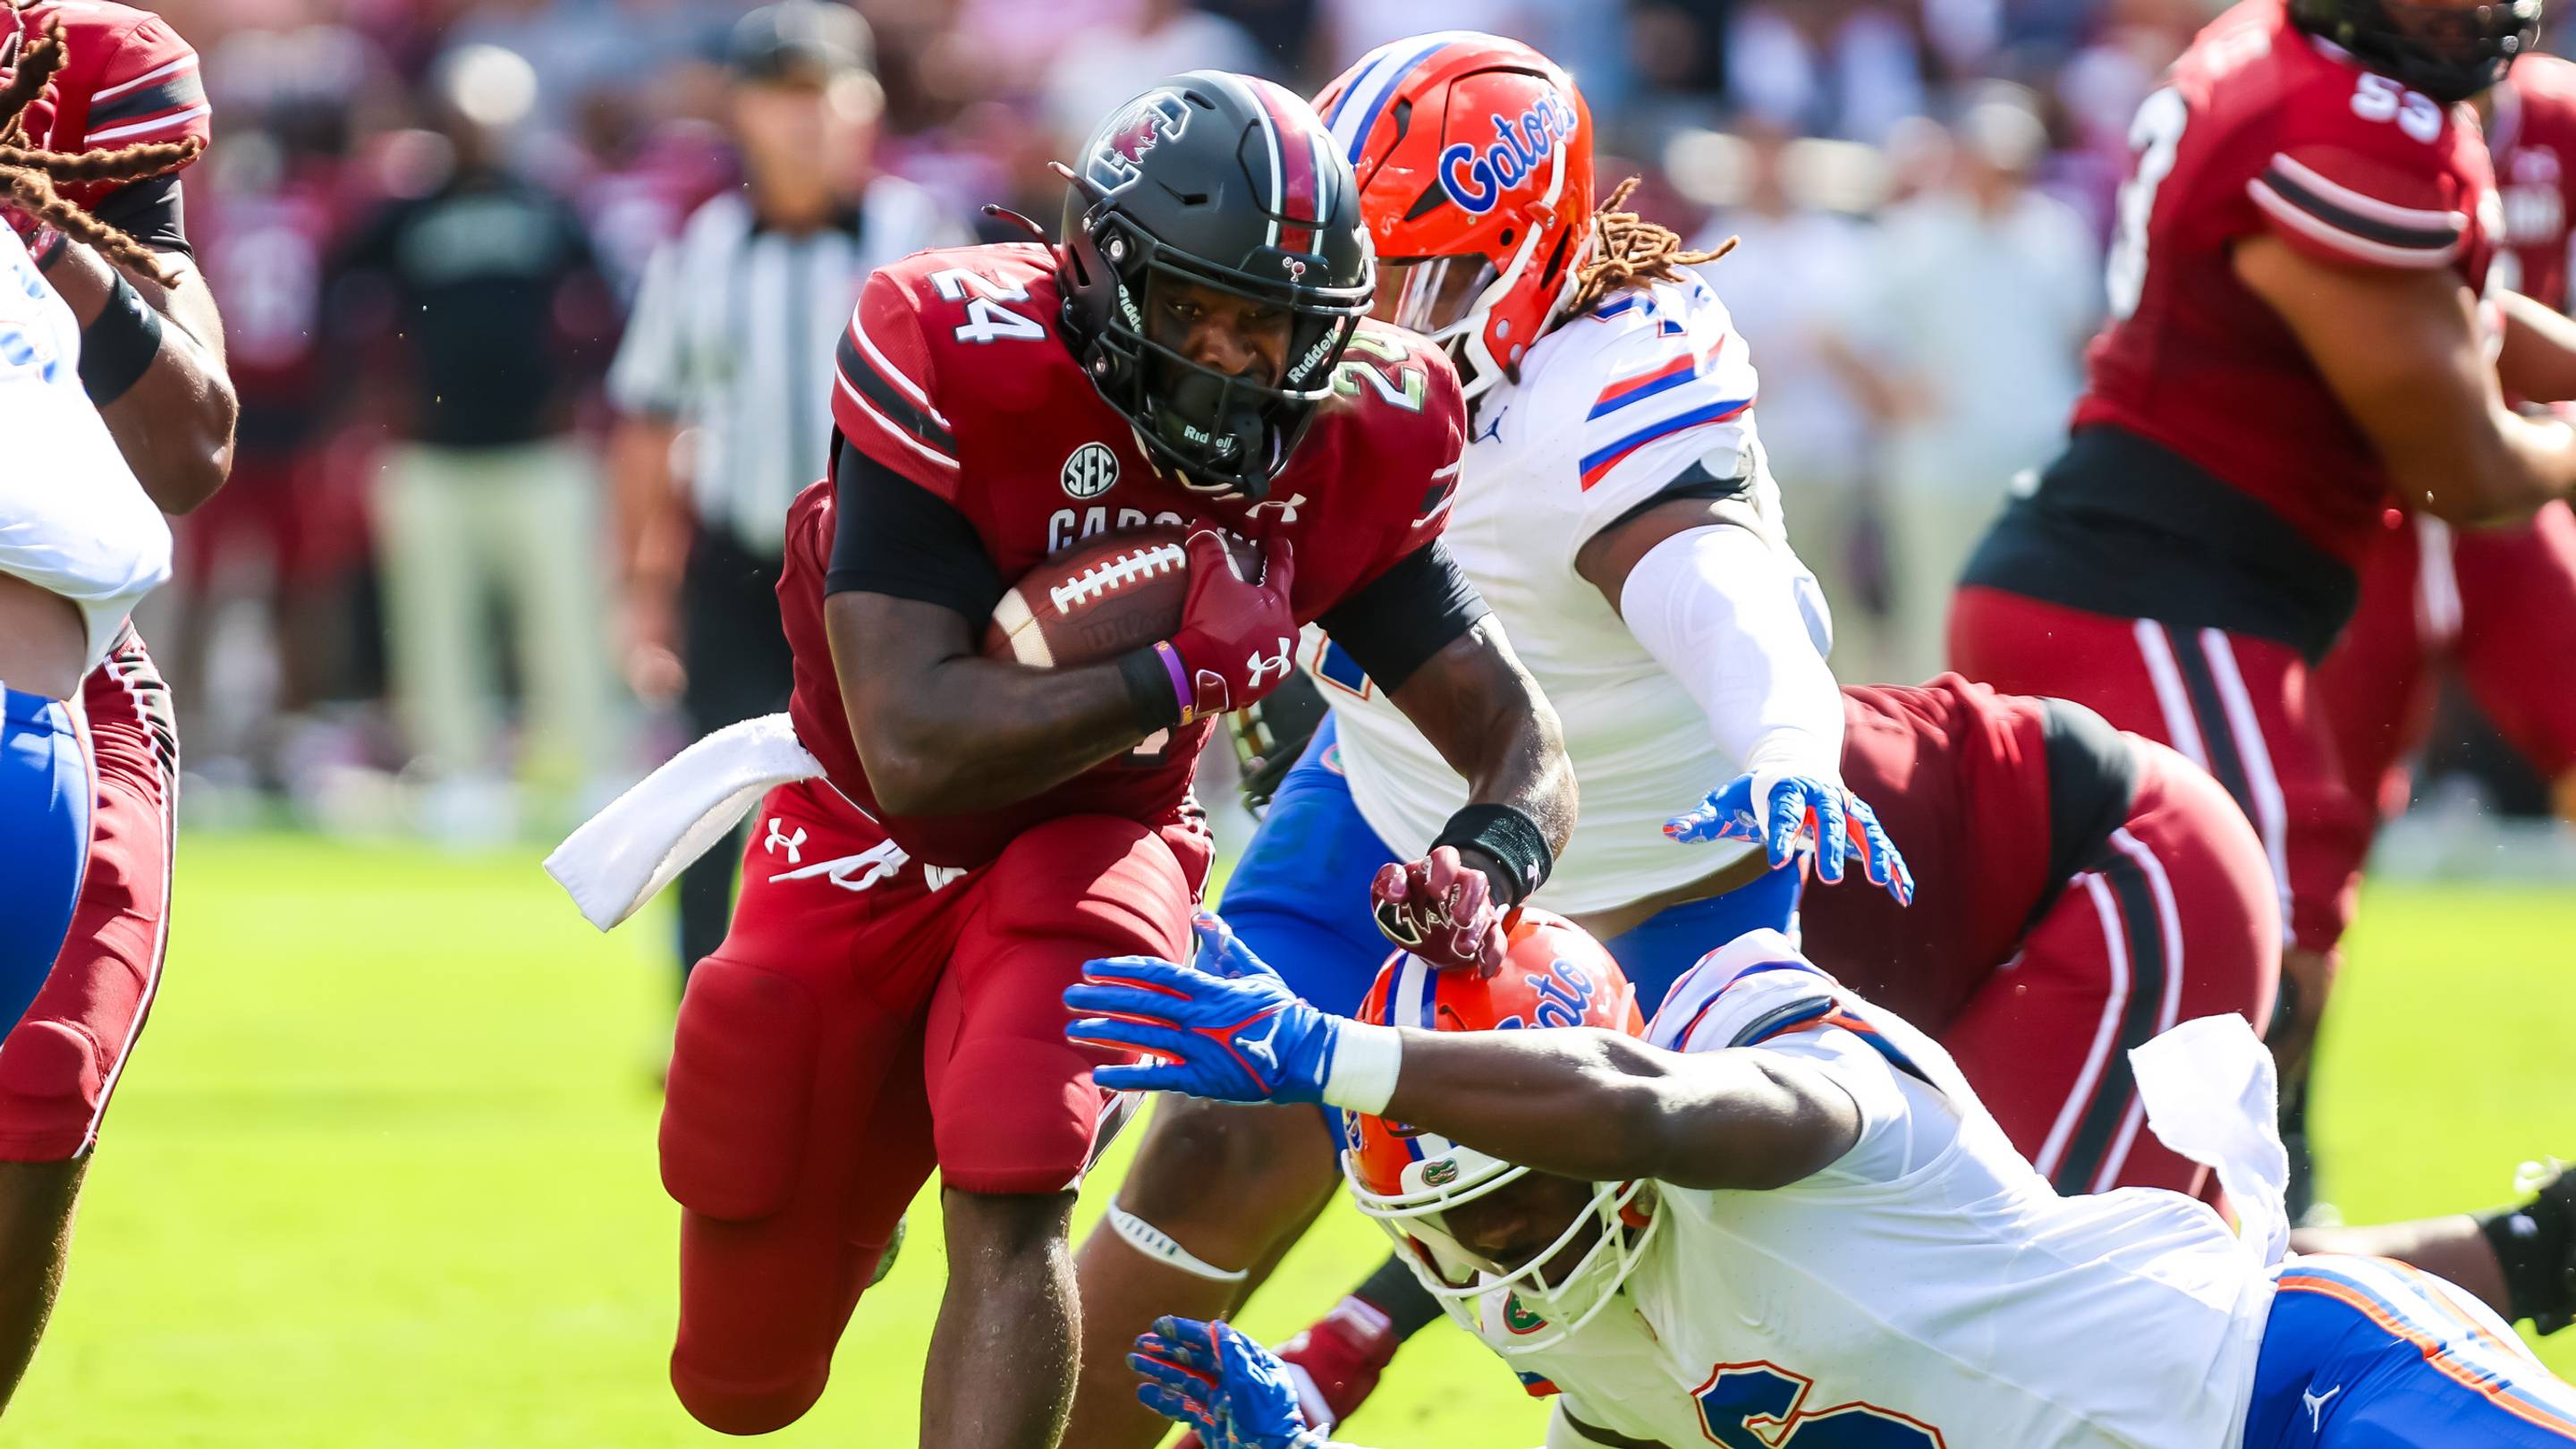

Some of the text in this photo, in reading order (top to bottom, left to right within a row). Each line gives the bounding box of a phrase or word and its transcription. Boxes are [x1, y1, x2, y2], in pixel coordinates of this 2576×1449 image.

[927, 267, 1048, 343] 24
[1118, 284, 1141, 334] Ridde
[1183, 424, 1233, 449] Ridell
[1067, 446, 1114, 496] SEC
